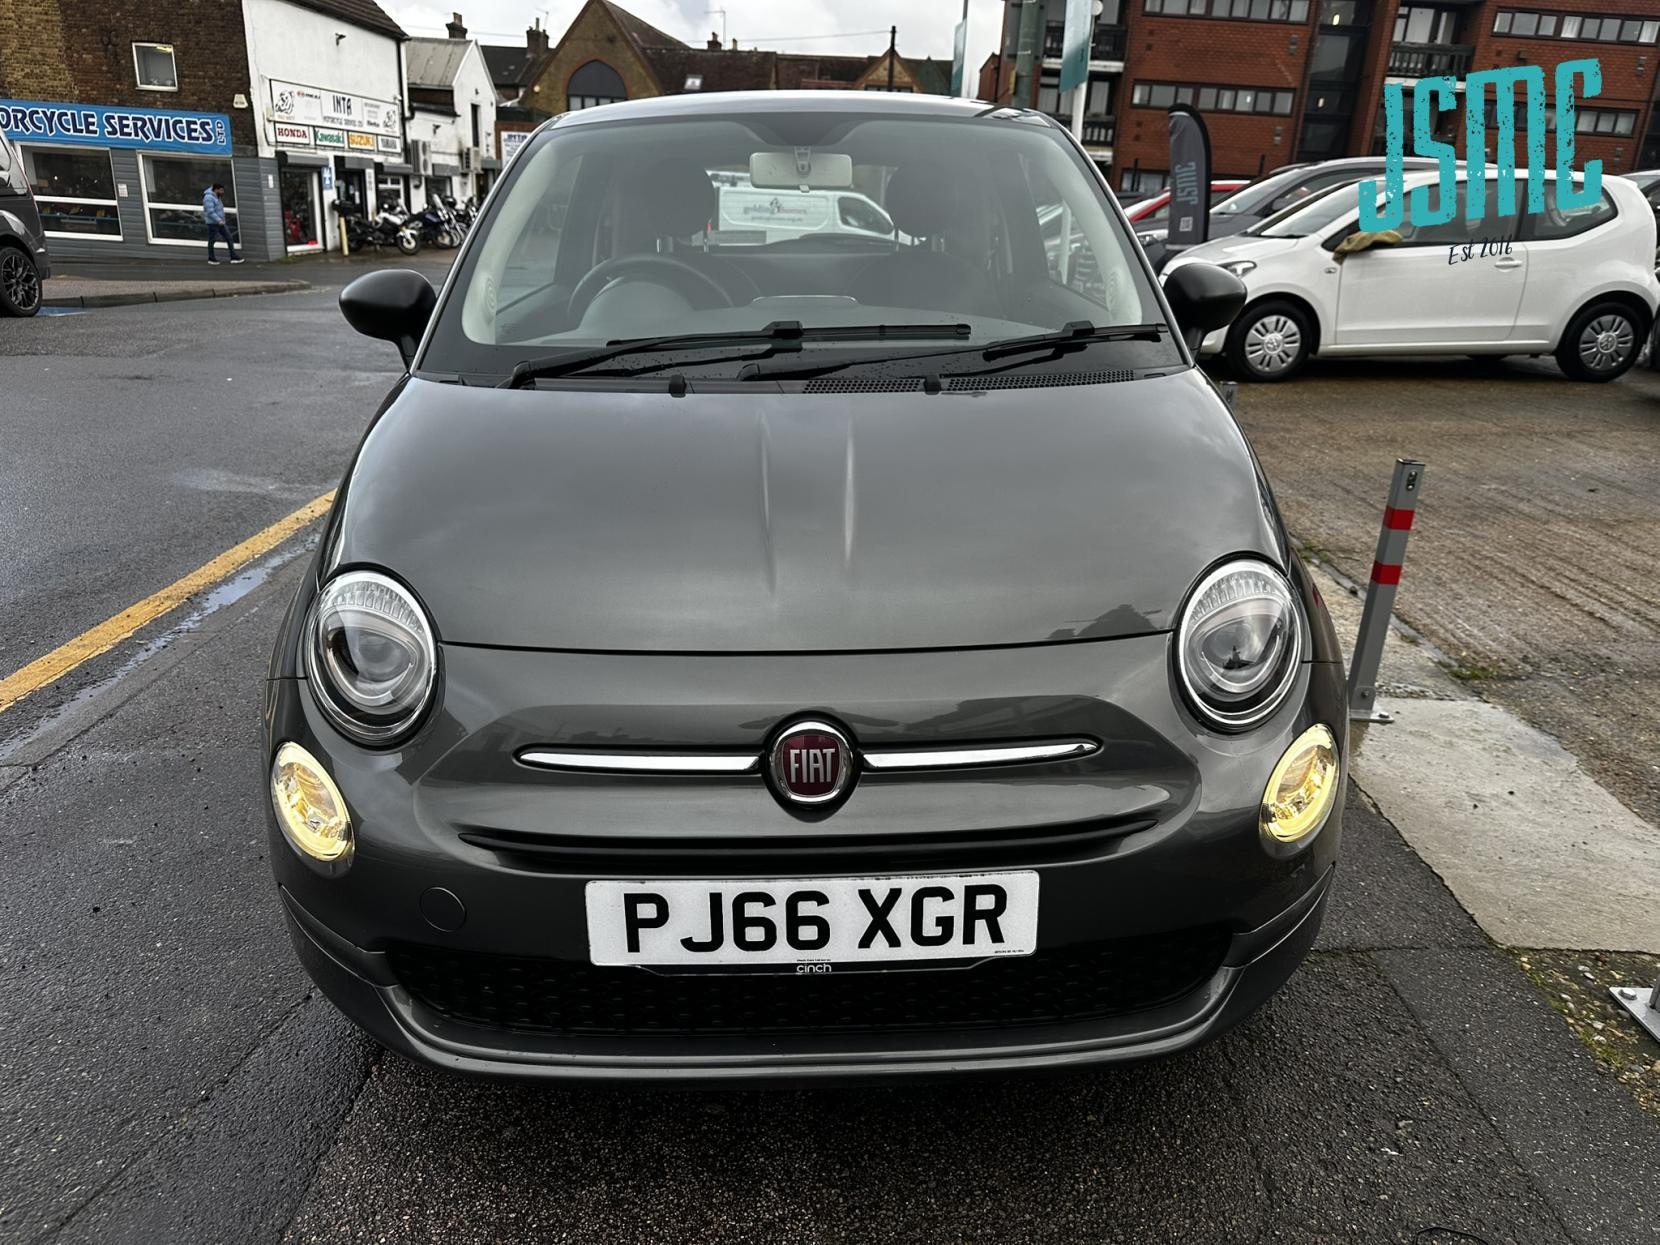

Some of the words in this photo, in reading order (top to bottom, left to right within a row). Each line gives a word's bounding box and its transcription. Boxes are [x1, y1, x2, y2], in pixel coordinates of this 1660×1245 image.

[103, 113, 214, 144] SERVICES
[215, 120, 226, 145] LTD
[277, 128, 307, 139] HONDA
[315, 130, 344, 144] Kawasaki
[349, 133, 374, 147] SUZUKI
[1175, 161, 1199, 205] JSMC
[790, 748, 836, 783] FIAT
[623, 889, 831, 953] PJ66
[857, 883, 1008, 949] XGR
[796, 962, 832, 973] cinch
